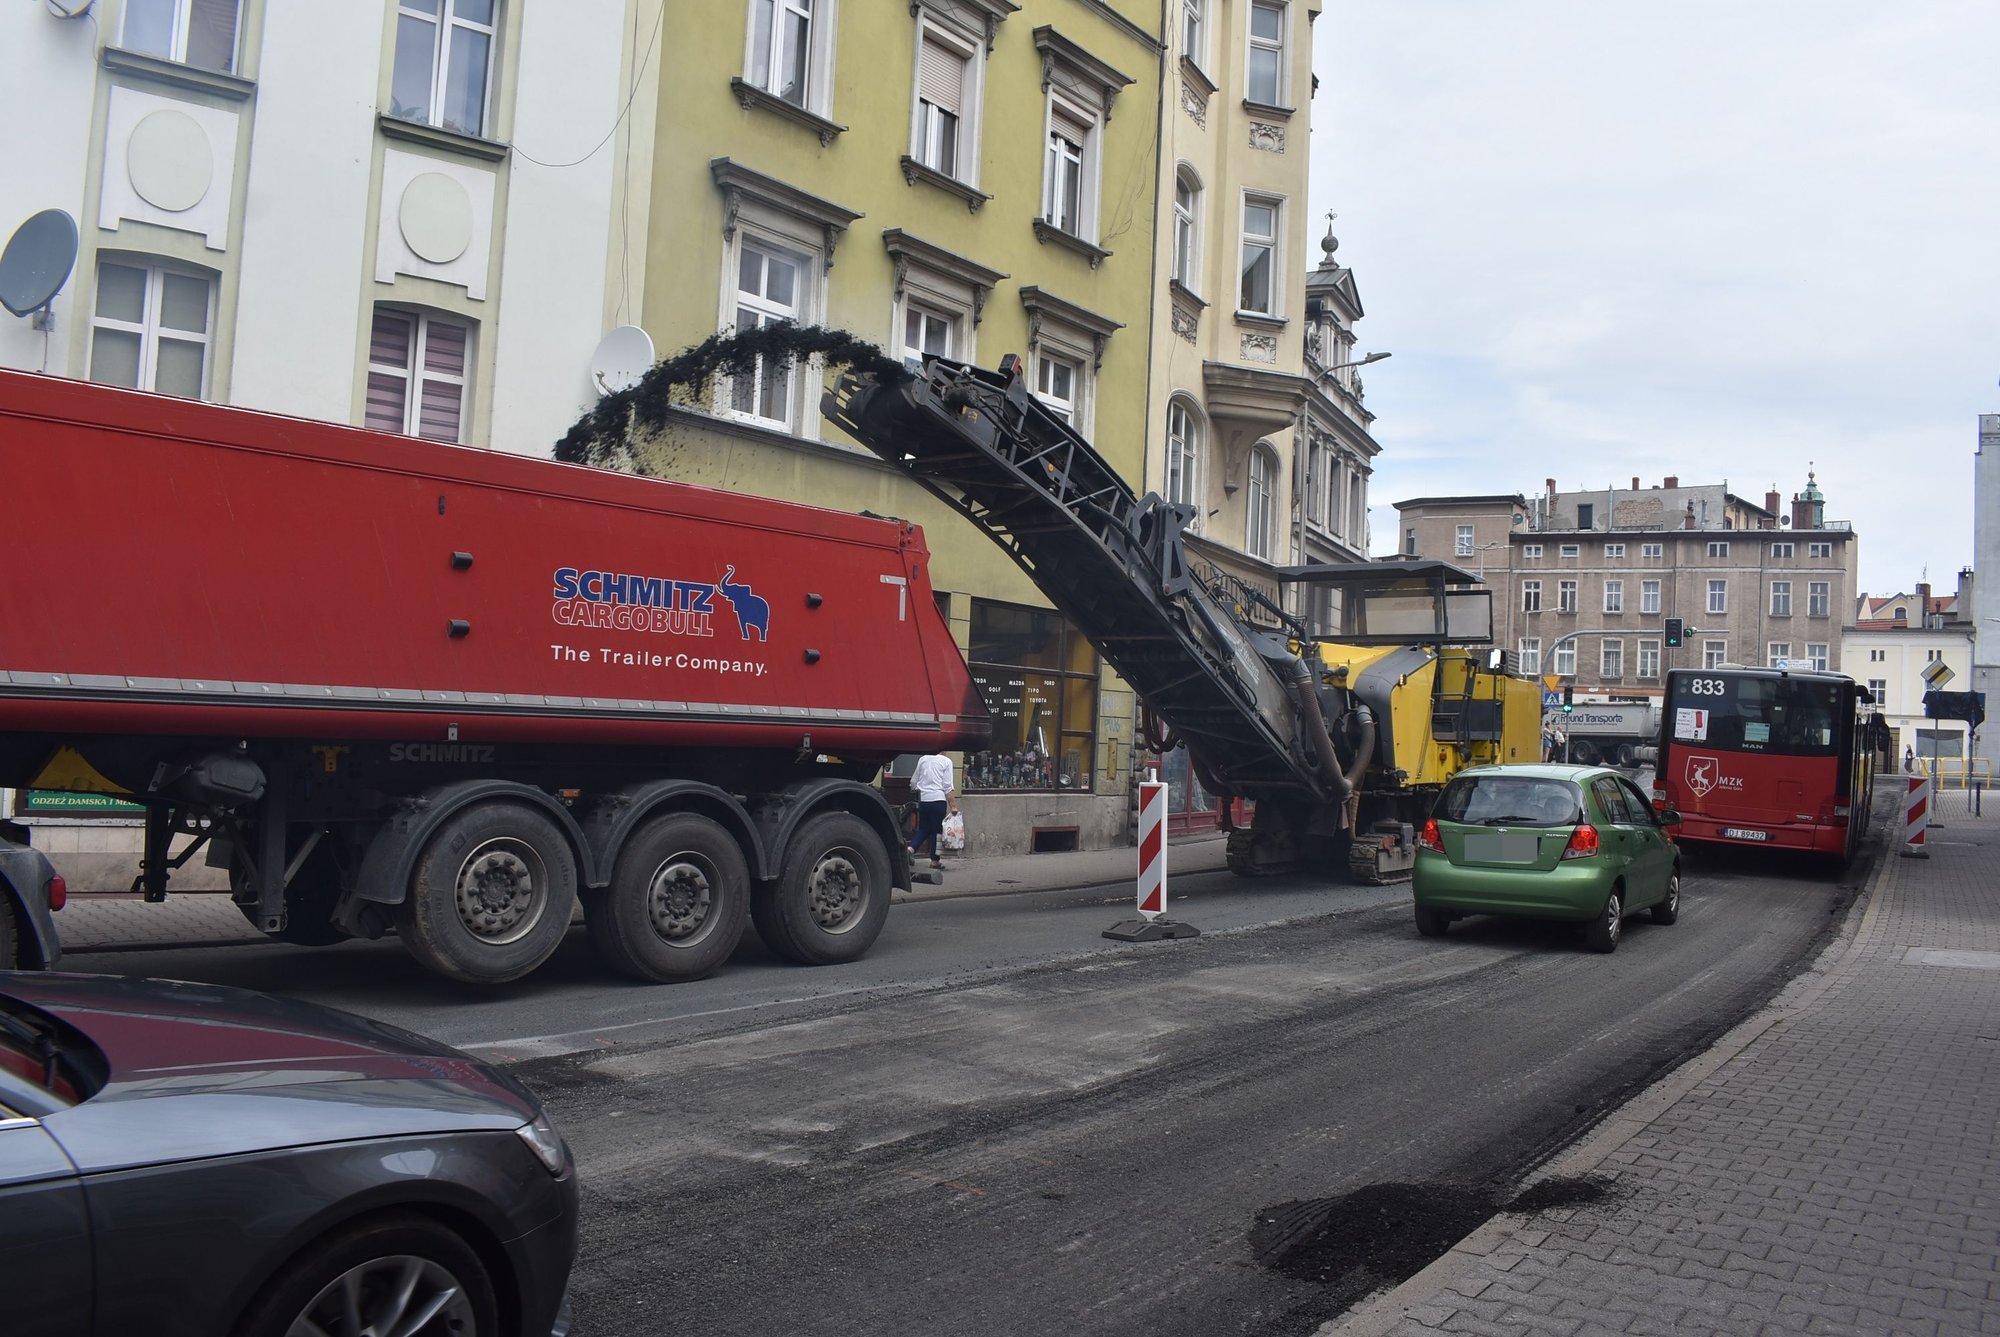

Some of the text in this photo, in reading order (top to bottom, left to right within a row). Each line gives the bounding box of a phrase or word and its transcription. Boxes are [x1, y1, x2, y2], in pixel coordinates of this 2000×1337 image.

[553, 567, 715, 614] SCHMITZ
[552, 599, 713, 637] CARGOBULL
[551, 645, 591, 662] The
[1691, 678, 1725, 696] 833
[1560, 713, 1623, 724] Frund Transporte
[389, 743, 496, 762] SCHMITZ
[1718, 776, 1744, 787] MZK
[32, 796, 66, 805] ODZIEŻ
[67, 798, 107, 806] DAMSKA
[1741, 830, 1765, 840] 89432
